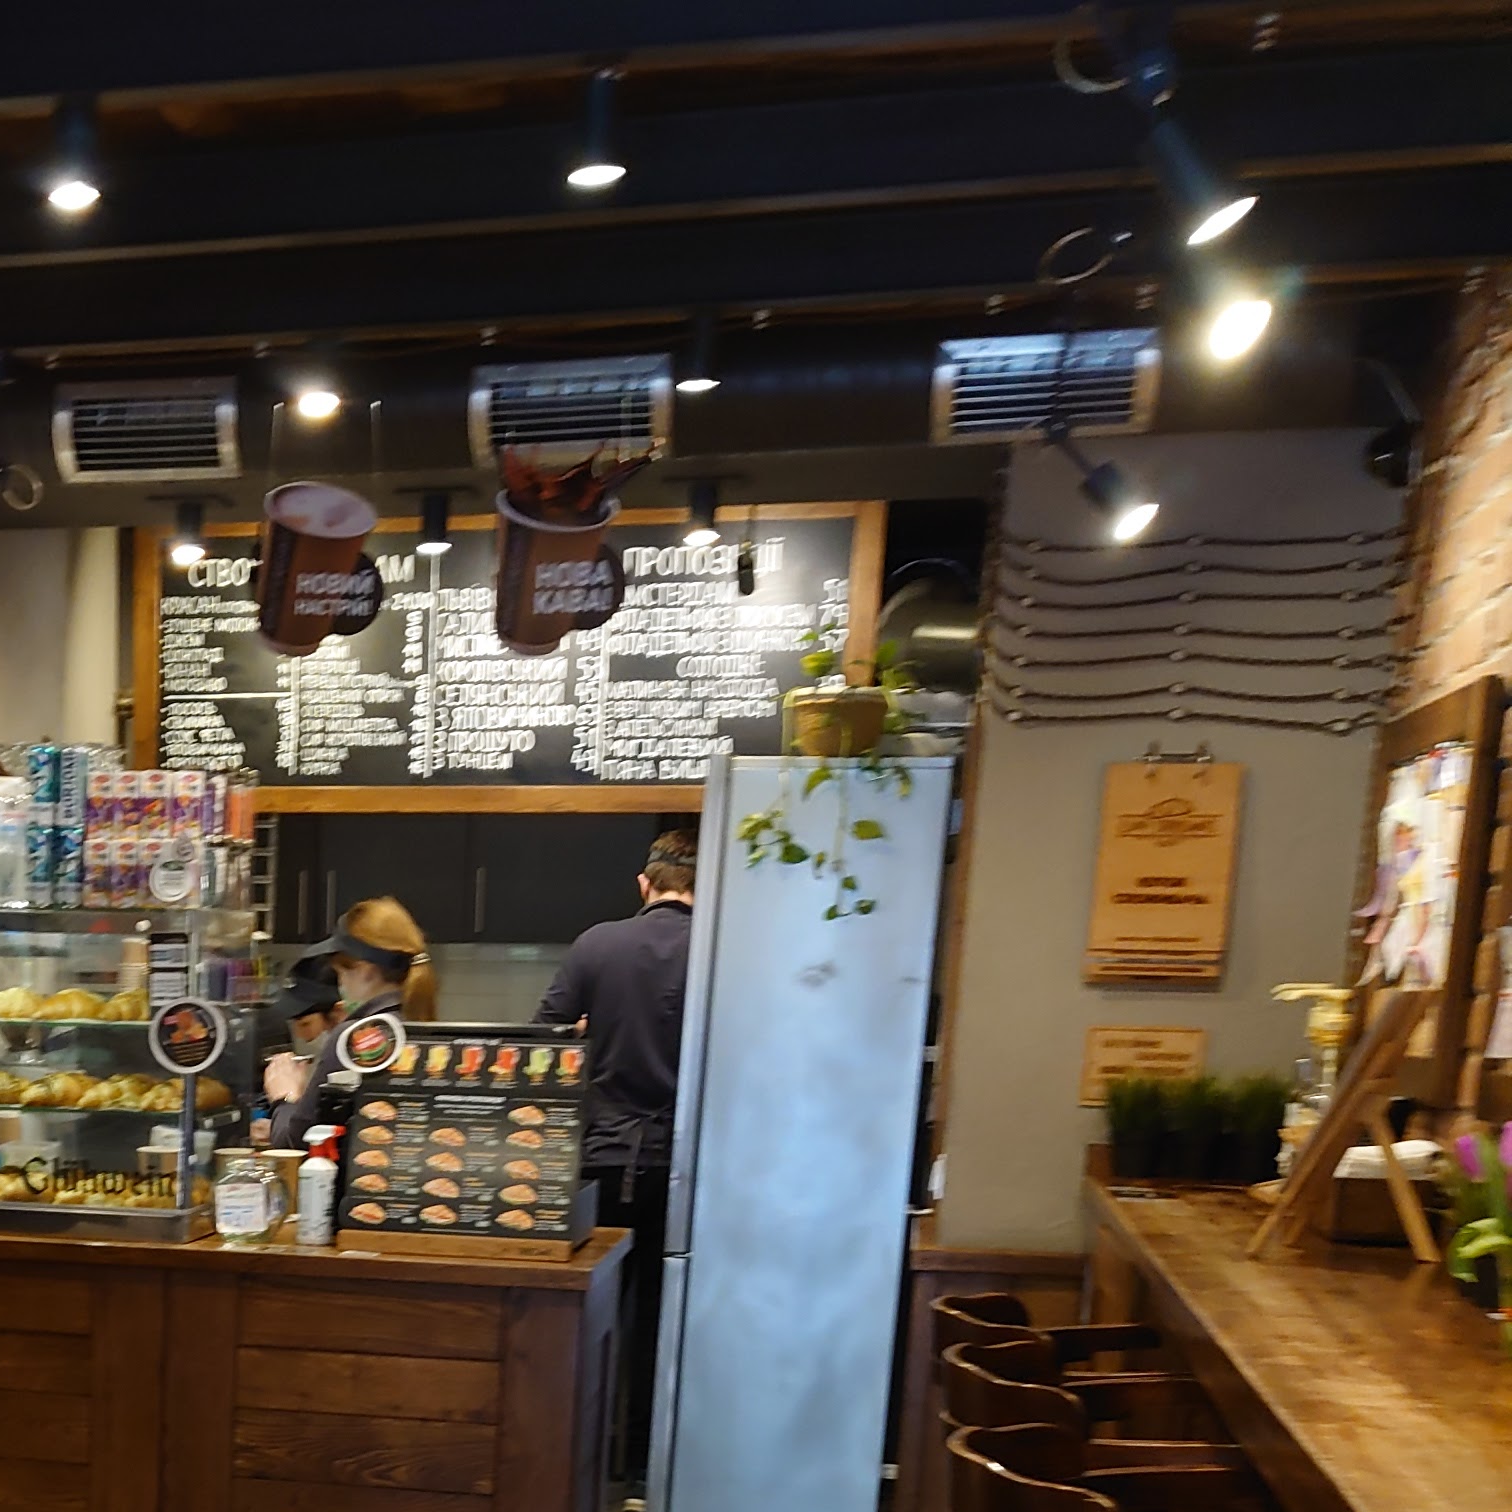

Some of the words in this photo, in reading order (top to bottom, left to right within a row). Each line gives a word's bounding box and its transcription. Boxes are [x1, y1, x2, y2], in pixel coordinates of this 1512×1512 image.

[188, 557, 263, 588] СТВО
[295, 569, 375, 595] НОВИЙ
[534, 560, 614, 589] НОВА
